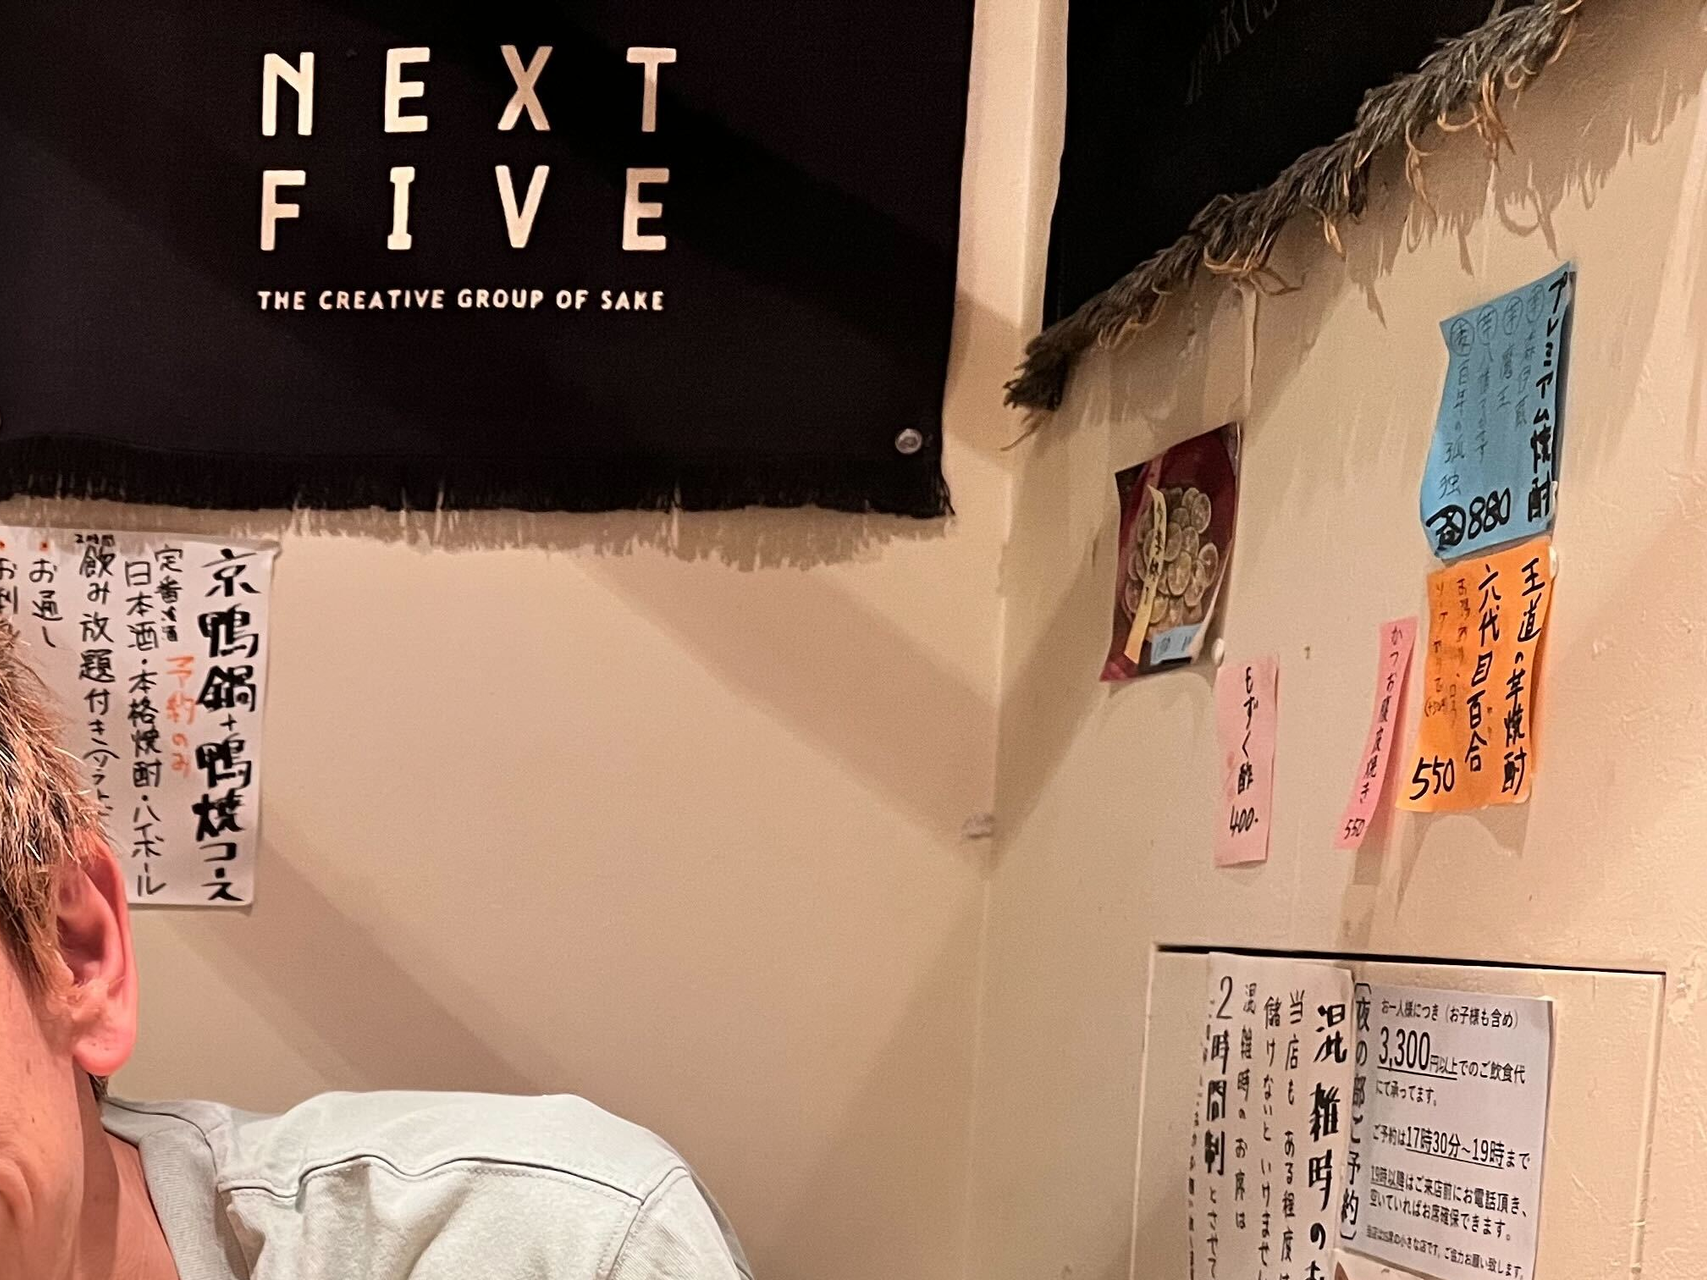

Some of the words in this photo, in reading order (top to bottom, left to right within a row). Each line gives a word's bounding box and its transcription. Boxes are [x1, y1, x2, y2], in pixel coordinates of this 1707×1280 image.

[261, 44, 677, 136] NEXT
[260, 164, 670, 252] FIVE
[257, 290, 306, 310] THE
[318, 289, 445, 310] CREATIVE
[457, 289, 543, 310] GROUP
[556, 289, 589, 310] OF
[601, 290, 664, 310] SAKE
[29, 558, 64, 648] お通し
[1409, 755, 1455, 800] 550
